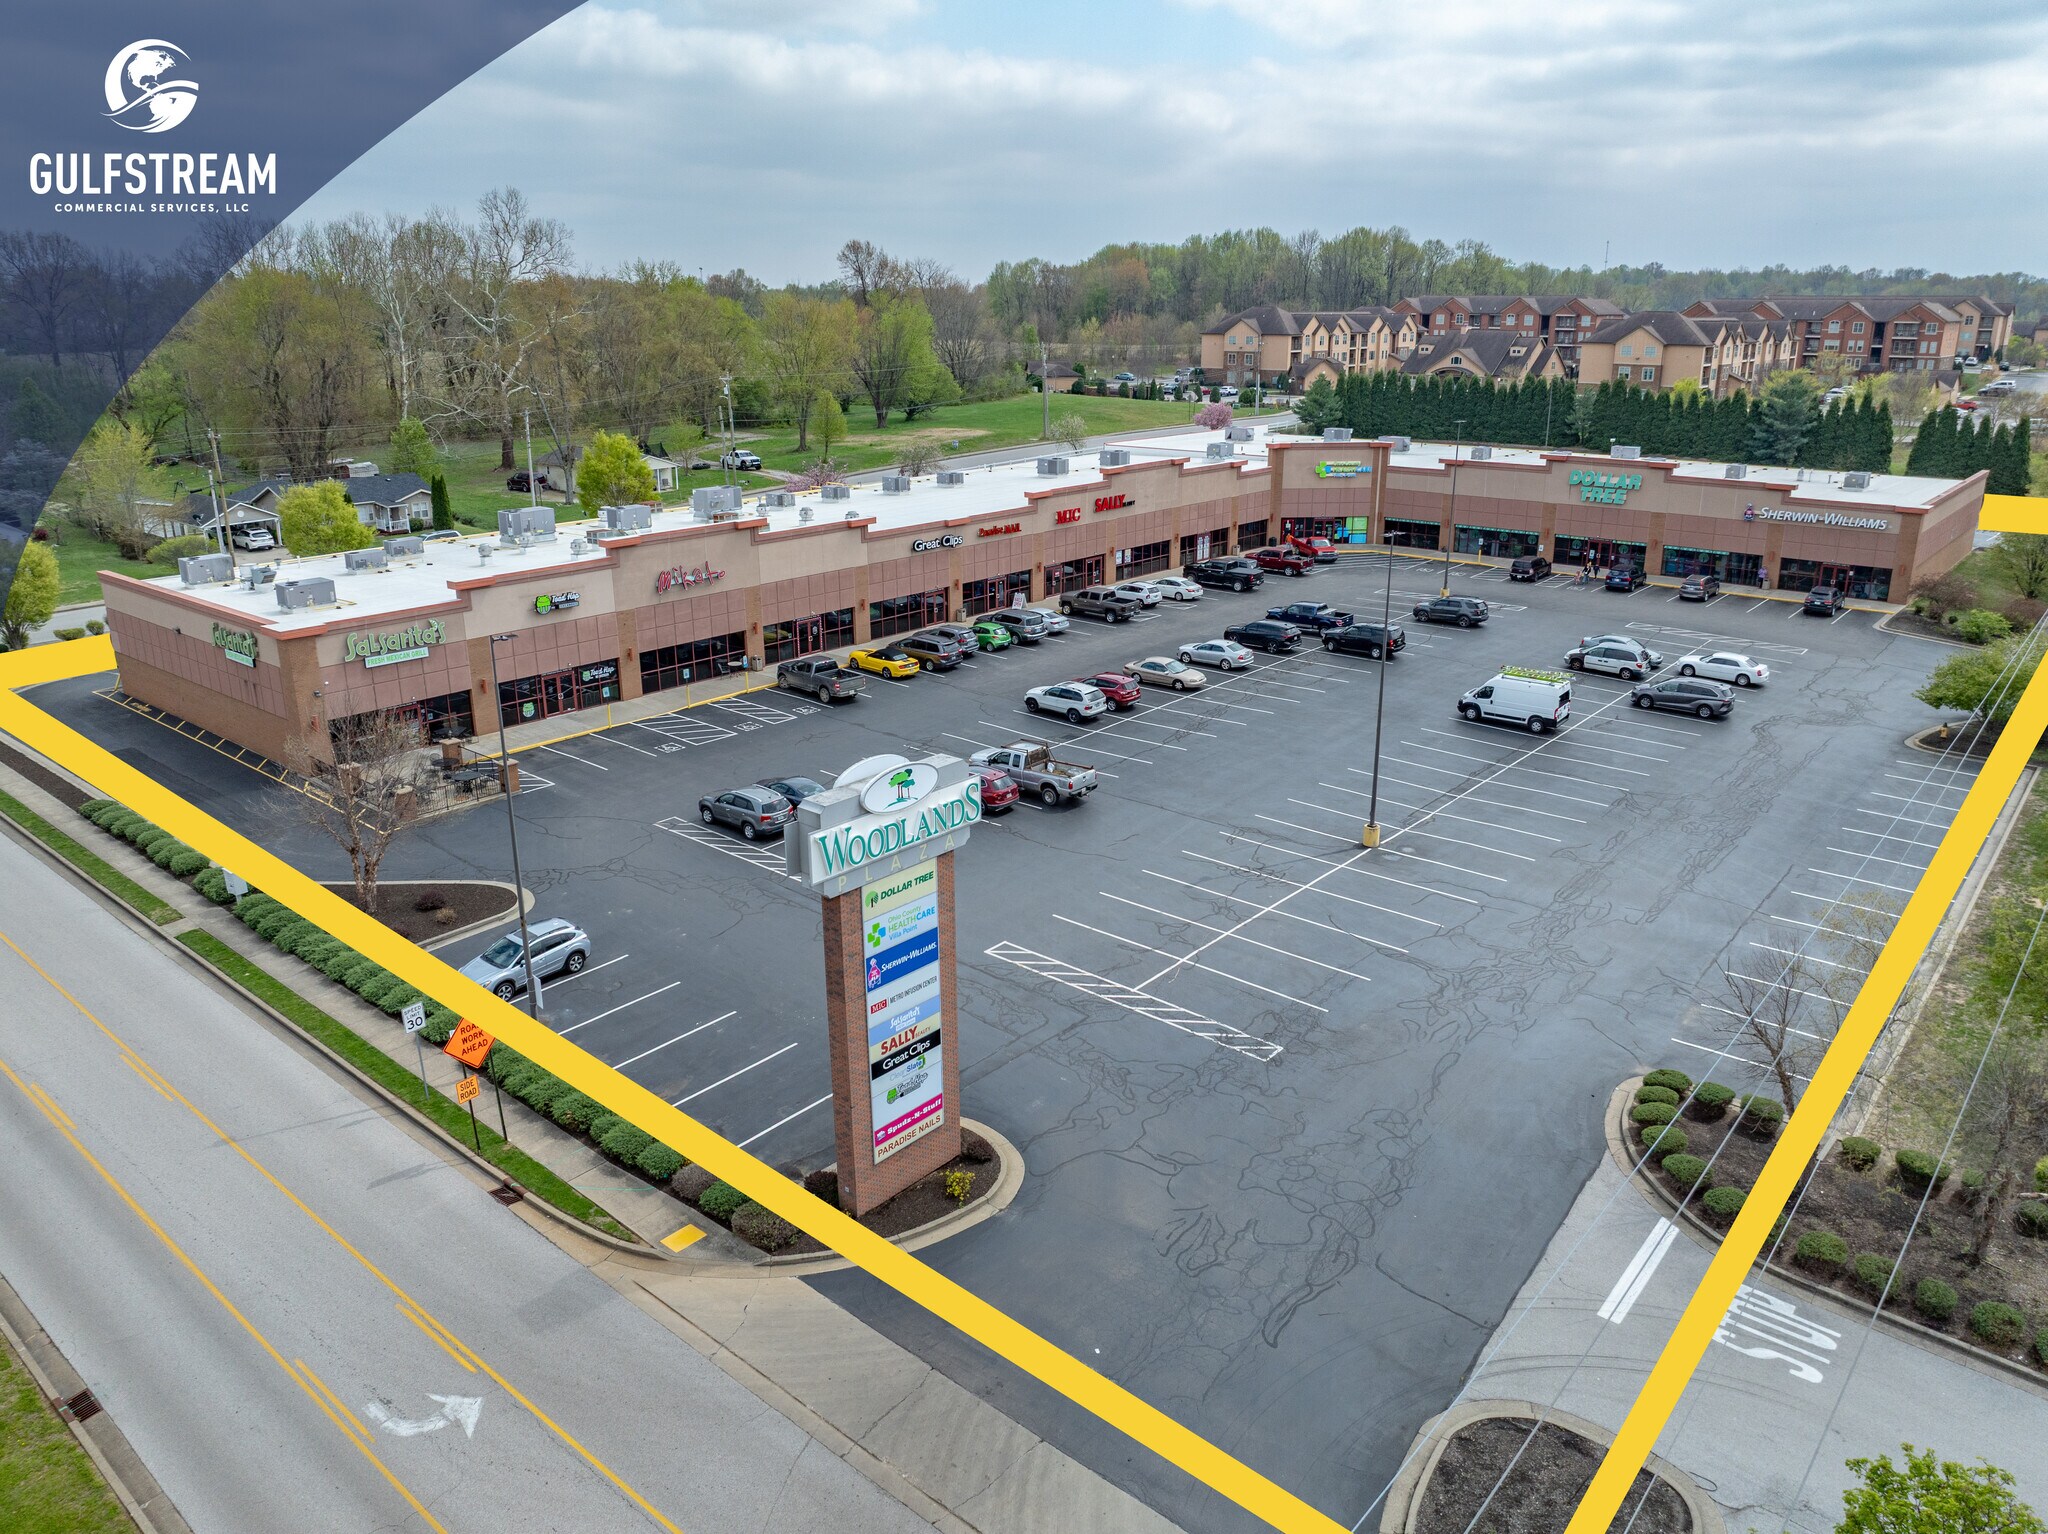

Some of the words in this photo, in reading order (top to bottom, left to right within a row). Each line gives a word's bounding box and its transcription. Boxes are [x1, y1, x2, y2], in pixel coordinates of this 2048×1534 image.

[1569, 469, 1642, 490] DOLLAR
[1095, 494, 1126, 513] SALLY
[1580, 486, 1627, 505] TREE
[1056, 507, 1081, 524] MIC
[914, 539, 940, 551] Great
[942, 535, 963, 548] Clips
[838, 834, 955, 893] PLAZA
[880, 880, 912, 900] DOLLAR
[913, 871, 934, 887] TREE
[887, 914, 902, 924] Ohio
[902, 905, 922, 918] County
[888, 906, 936, 933] HEALTHCARE
[902, 924, 918, 935] Point
[404, 1005, 422, 1015] SPEED
[406, 1011, 421, 1021] LIMIT
[407, 1016, 423, 1030] 30
[460, 1023, 480, 1036] ROA
[461, 1030, 484, 1045] WORK
[880, 1026, 918, 1056] SALLY
[461, 1038, 488, 1056] AHEAD
[882, 1051, 909, 1070] Great
[909, 1040, 931, 1057] Clips
[459, 1079, 475, 1092] SIDE
[459, 1087, 477, 1101] ROAD
[877, 1129, 916, 1158] PARADISE
[918, 1115, 941, 1133] NAILS
[1712, 1283, 1842, 1384] STOP
